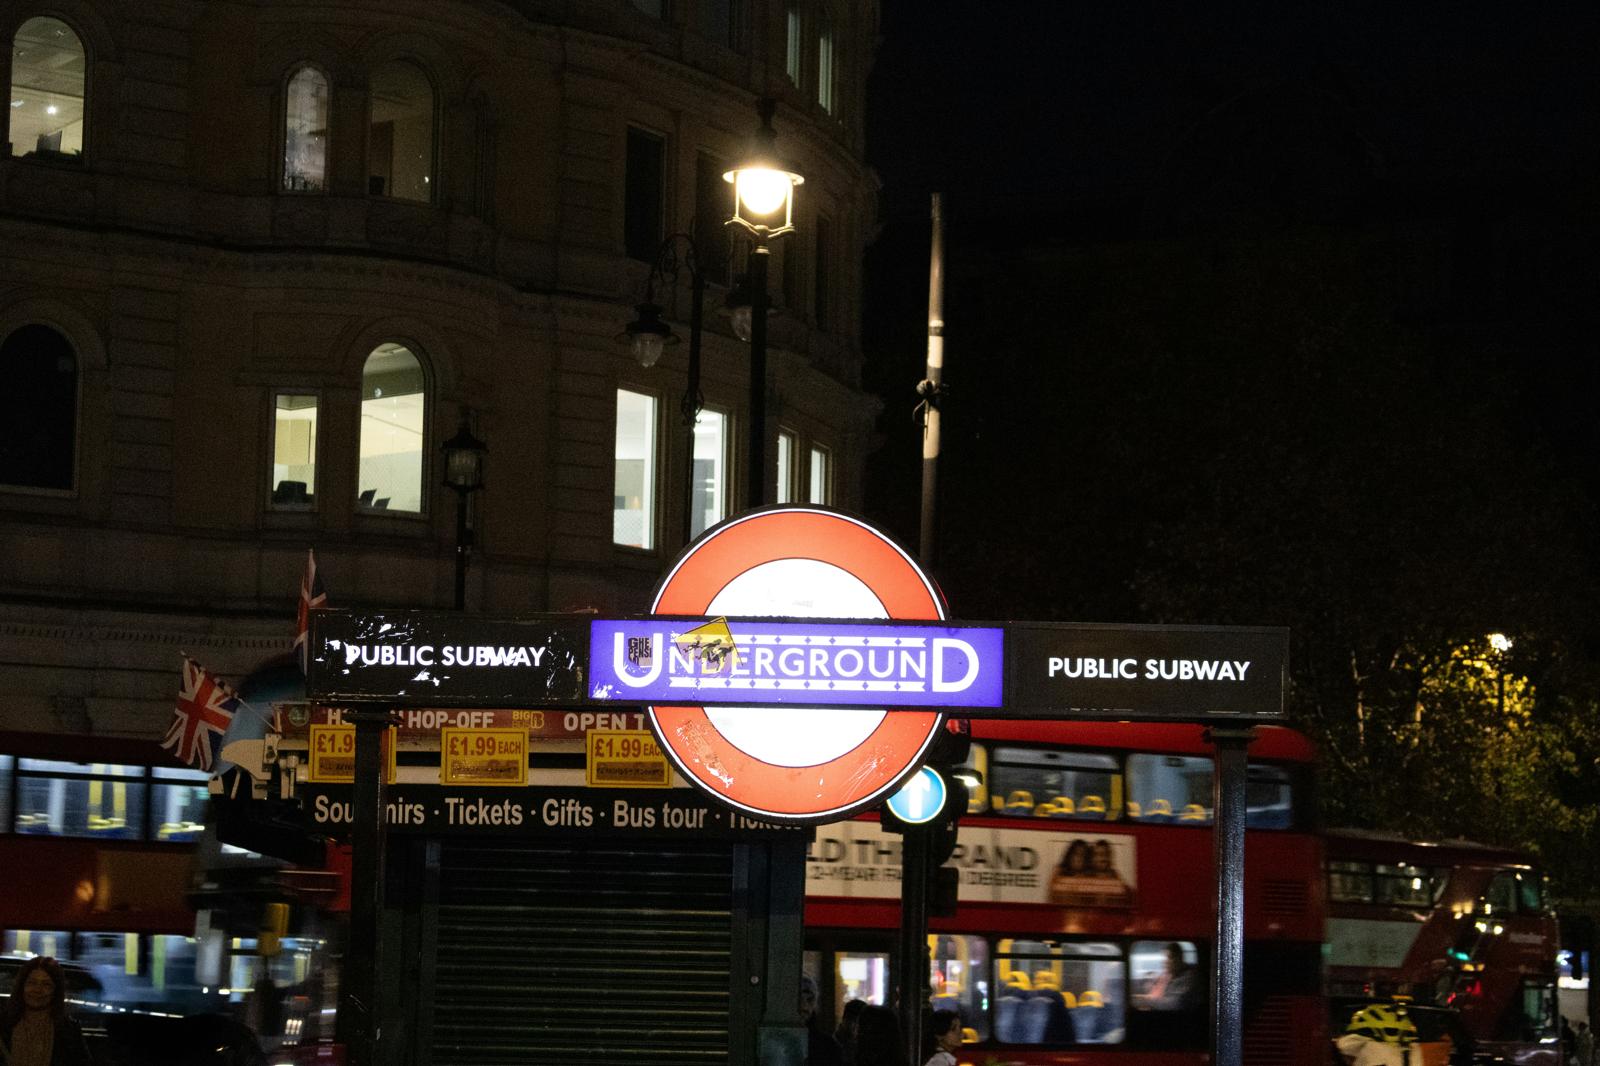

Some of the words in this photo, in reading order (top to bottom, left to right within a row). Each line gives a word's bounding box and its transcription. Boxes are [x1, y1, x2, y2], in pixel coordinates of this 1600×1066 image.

[345, 644, 433, 666] PUBLIC
[441, 645, 546, 667] SUBWAY
[613, 632, 980, 694] UNDERGROUND
[1048, 657, 1138, 680] PUBLIC
[1145, 659, 1251, 682] SUBWAY
[408, 711, 494, 729] HOP-OFF
[512, 711, 530, 720] BIG
[563, 712, 627, 732] OPEN
[317, 733, 354, 753] £1.9
[449, 736, 497, 757] £1.99
[498, 739, 521, 755] EACH
[594, 738, 641, 758] £1.99
[643, 742, 665, 757] EAC
[314, 794, 426, 826] Sounirs
[444, 797, 525, 827] Tickets
[542, 797, 595, 829] Gifts
[613, 800, 656, 829] Bus
[662, 802, 708, 830] tour
[851, 839, 904, 867] TH
